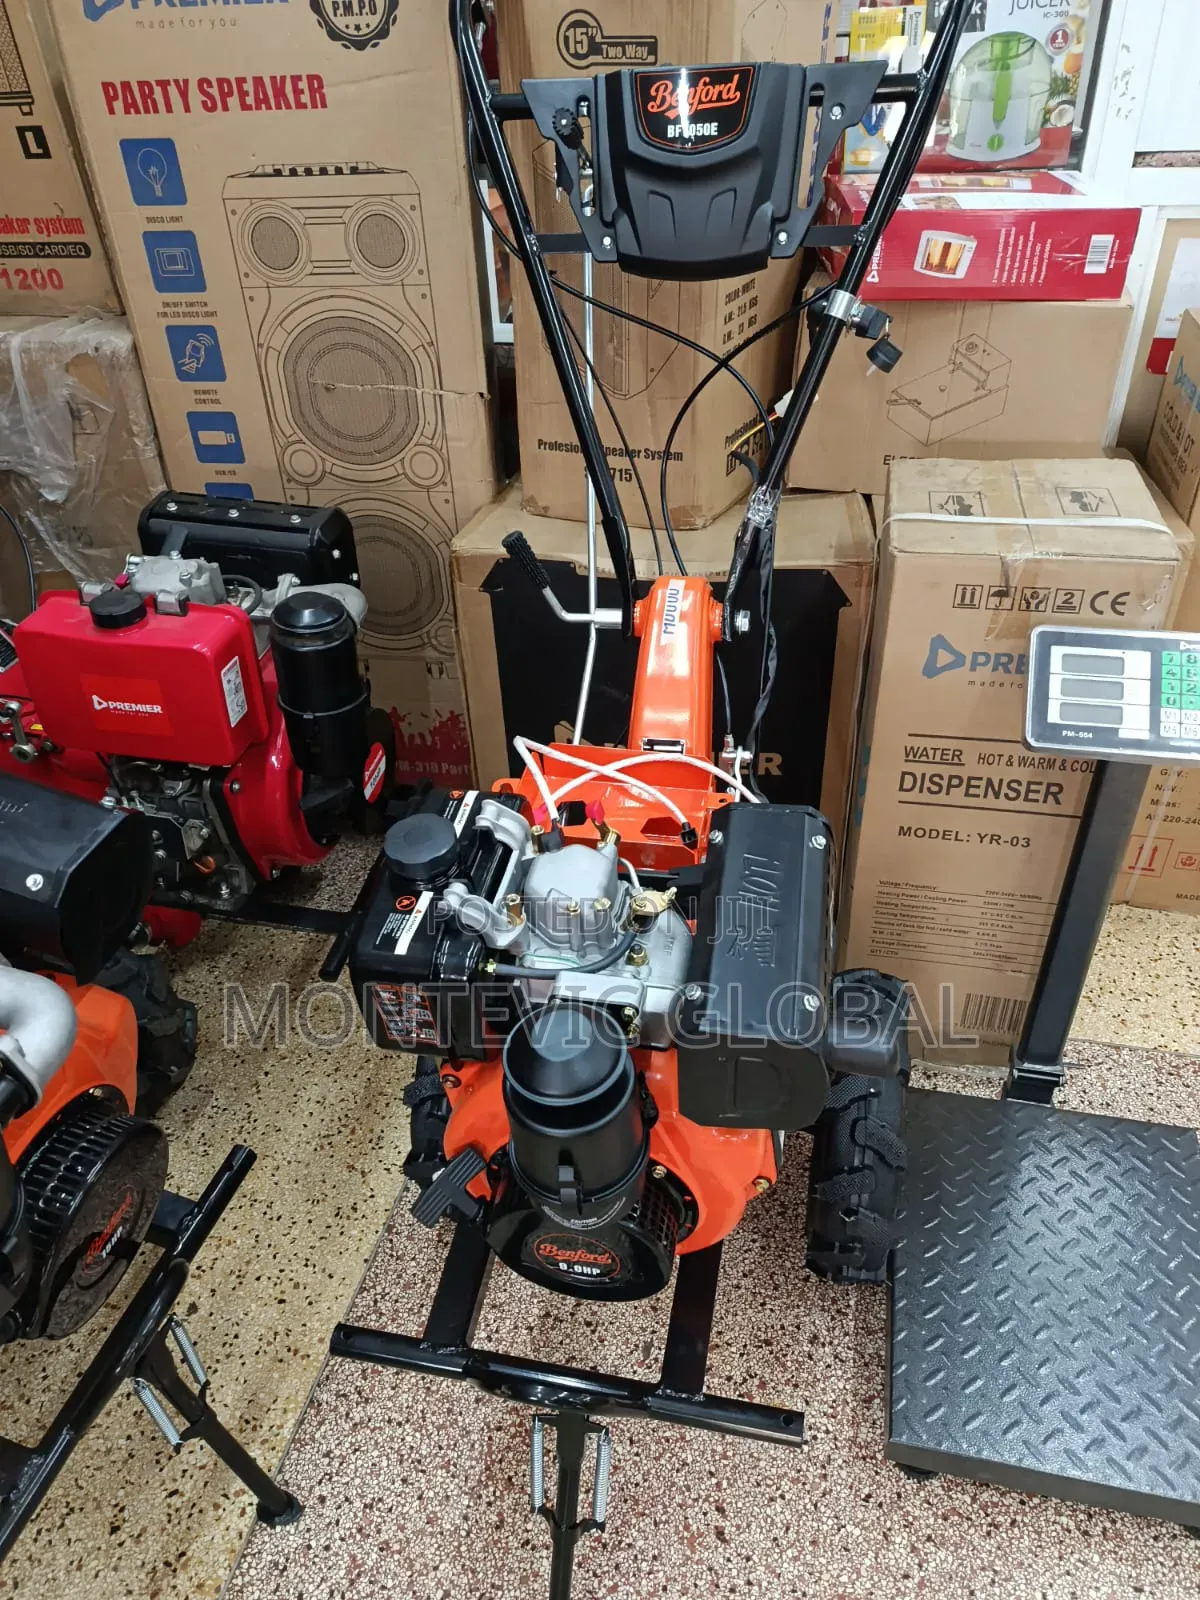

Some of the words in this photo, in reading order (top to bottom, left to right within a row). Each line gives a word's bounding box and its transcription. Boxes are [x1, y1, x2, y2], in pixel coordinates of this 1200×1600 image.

[601, 45, 622, 58] Two
[625, 45, 648, 60] Way
[101, 78, 192, 116] PARTY
[197, 73, 328, 113] SPEAKER
[667, 122, 719, 138] BF050E
[33, 214, 86, 238] system
[36, 244, 86, 256] CARD/EQ
[1167, 653, 1174, 663] 7
[1186, 654, 1197, 664] 8
[1166, 668, 1177, 678] 4
[1186, 683, 1197, 693] 2
[108, 700, 163, 714] PREMIER
[904, 745, 963, 762] WATER
[977, 752, 1004, 767] HOT
[1006, 754, 1014, 767] &
[1018, 755, 1055, 770] WARM
[1058, 759, 1067, 771] &
[898, 770, 1064, 806] DISPENSER
[897, 825, 972, 843] MODEL:
[976, 832, 1032, 849] YR-03
